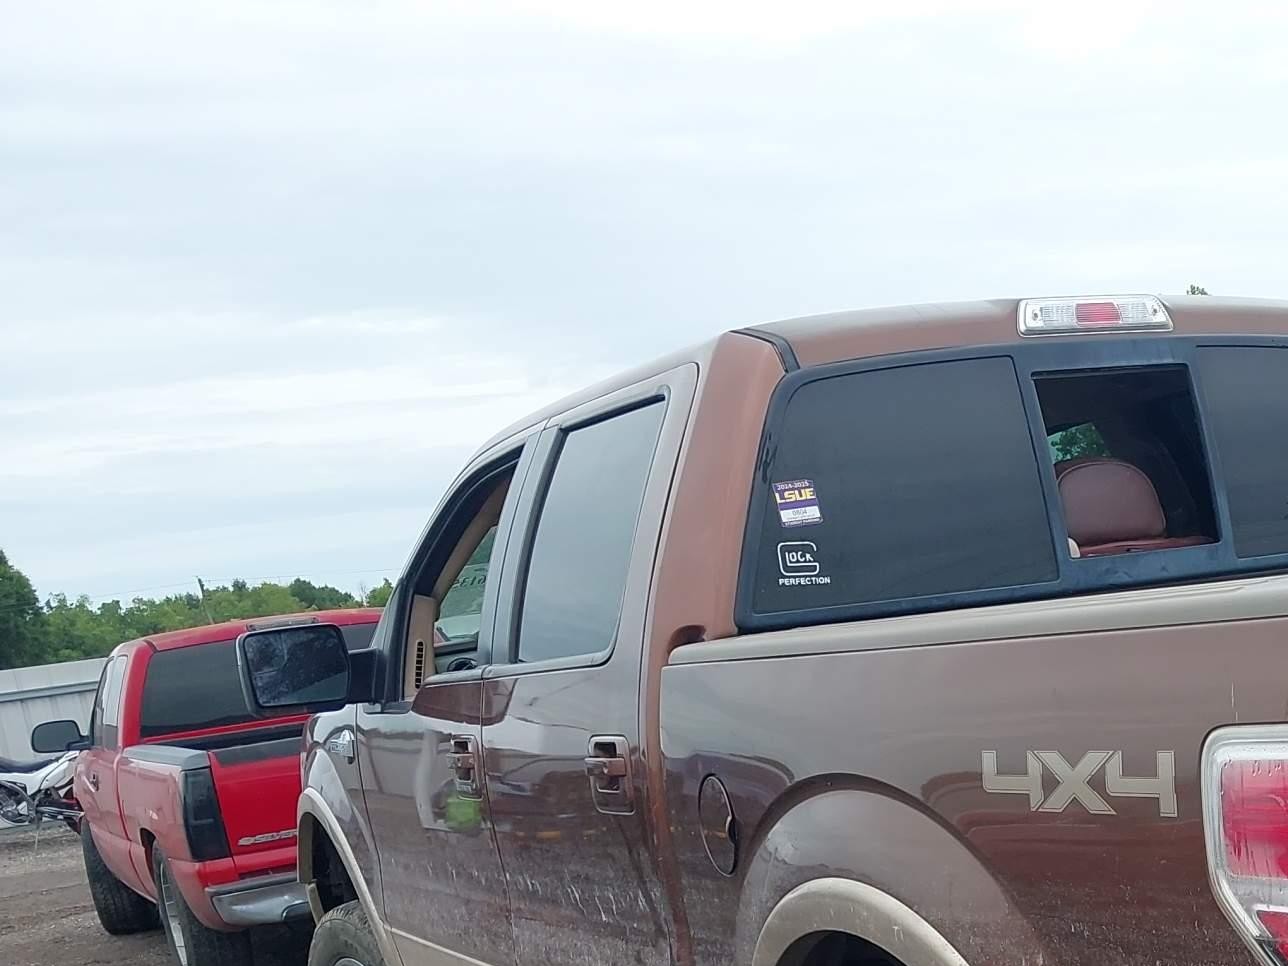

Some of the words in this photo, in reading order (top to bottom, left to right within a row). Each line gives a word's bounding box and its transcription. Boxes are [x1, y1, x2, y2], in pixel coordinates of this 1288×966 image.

[775, 488, 816, 503] LSUE
[778, 576, 831, 586] PERFECTION
[981, 750, 1178, 818] 4X4
